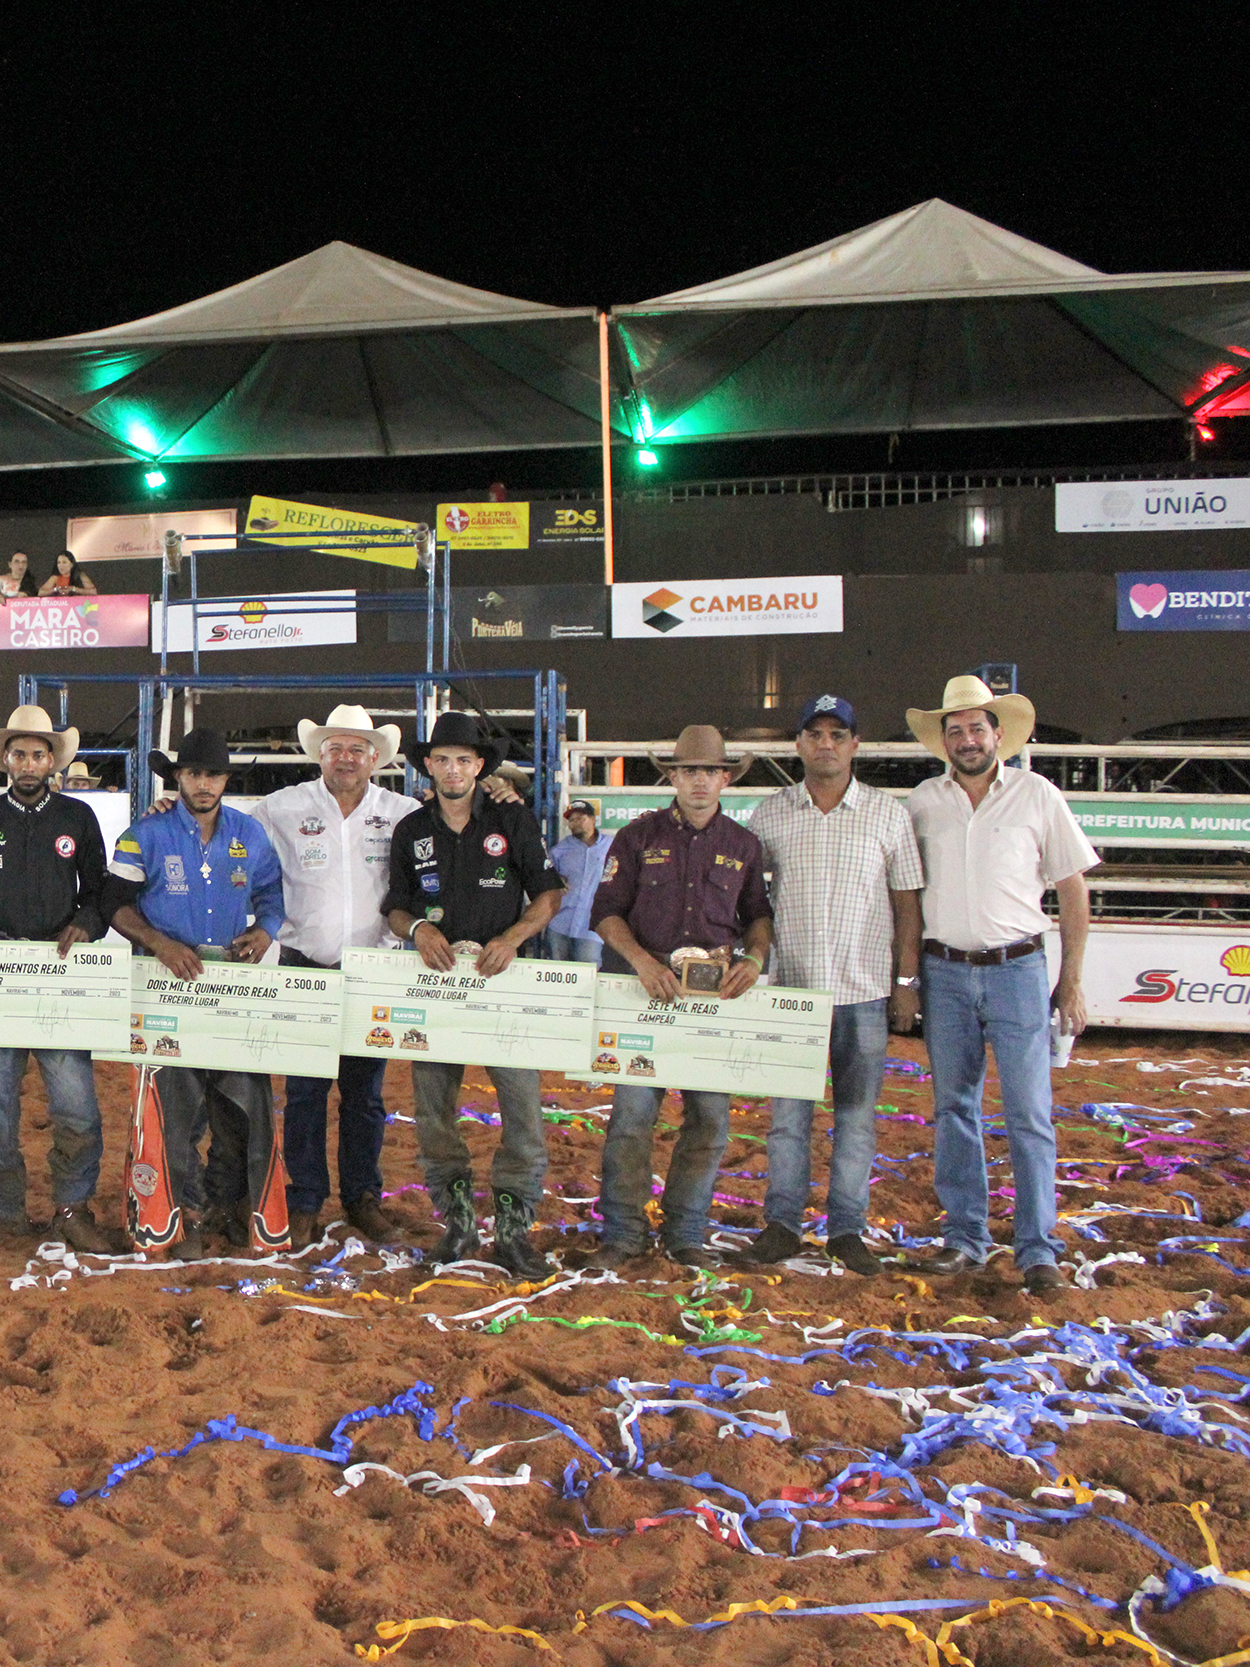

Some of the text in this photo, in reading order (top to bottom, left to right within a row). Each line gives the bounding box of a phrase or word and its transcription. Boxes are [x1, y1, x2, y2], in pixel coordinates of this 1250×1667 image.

[1146, 492, 1226, 514] UNIÃO
[471, 517, 517, 525] GARRINCHA
[690, 592, 818, 613] CAMBARU
[10, 607, 81, 630] MARA
[756, 611, 818, 620] CONSTRUÇÃO
[10, 628, 99, 647] CASEIRO
[1073, 814, 1186, 829] PREFEITURA
[165, 884, 189, 892] SONORA
[40, 964, 67, 975] REAIS
[416, 972, 486, 989] TRÊS MIL REAIS
[1118, 969, 1250, 1004] Stefa
[147, 979, 278, 999] DOIS MIL E QUINHENTOS REAIS
[406, 988, 468, 1001] SEGUNDO LUGAR
[159, 994, 220, 1007] TERCEIRO LUGAR
[647, 1000, 719, 1015] SETE MIL REAIS
[637, 1013, 676, 1025] CAMPEÃO
